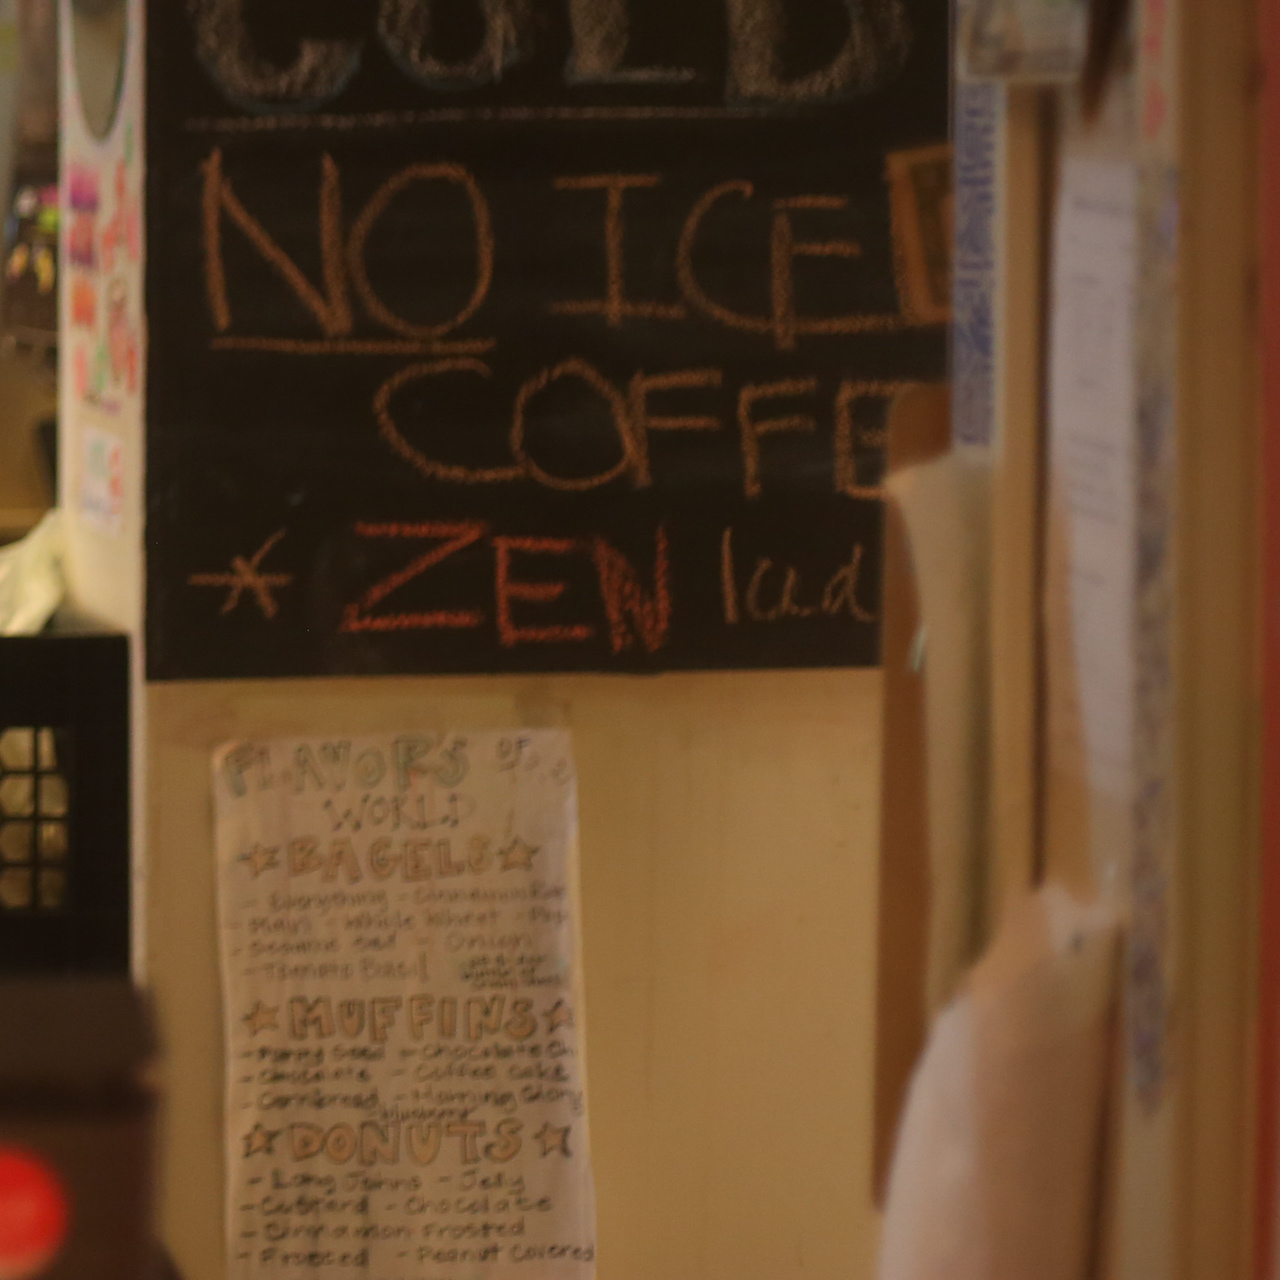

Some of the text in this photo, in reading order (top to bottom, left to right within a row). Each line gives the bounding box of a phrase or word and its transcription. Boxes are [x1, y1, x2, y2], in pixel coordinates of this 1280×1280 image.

[200, 147, 494, 339] NO
[341, 522, 674, 654] ZEN
[286, 833, 493, 883] BAGELS
[287, 994, 538, 1043] MUFFINS
[287, 1117, 524, 1166] DONUTS
